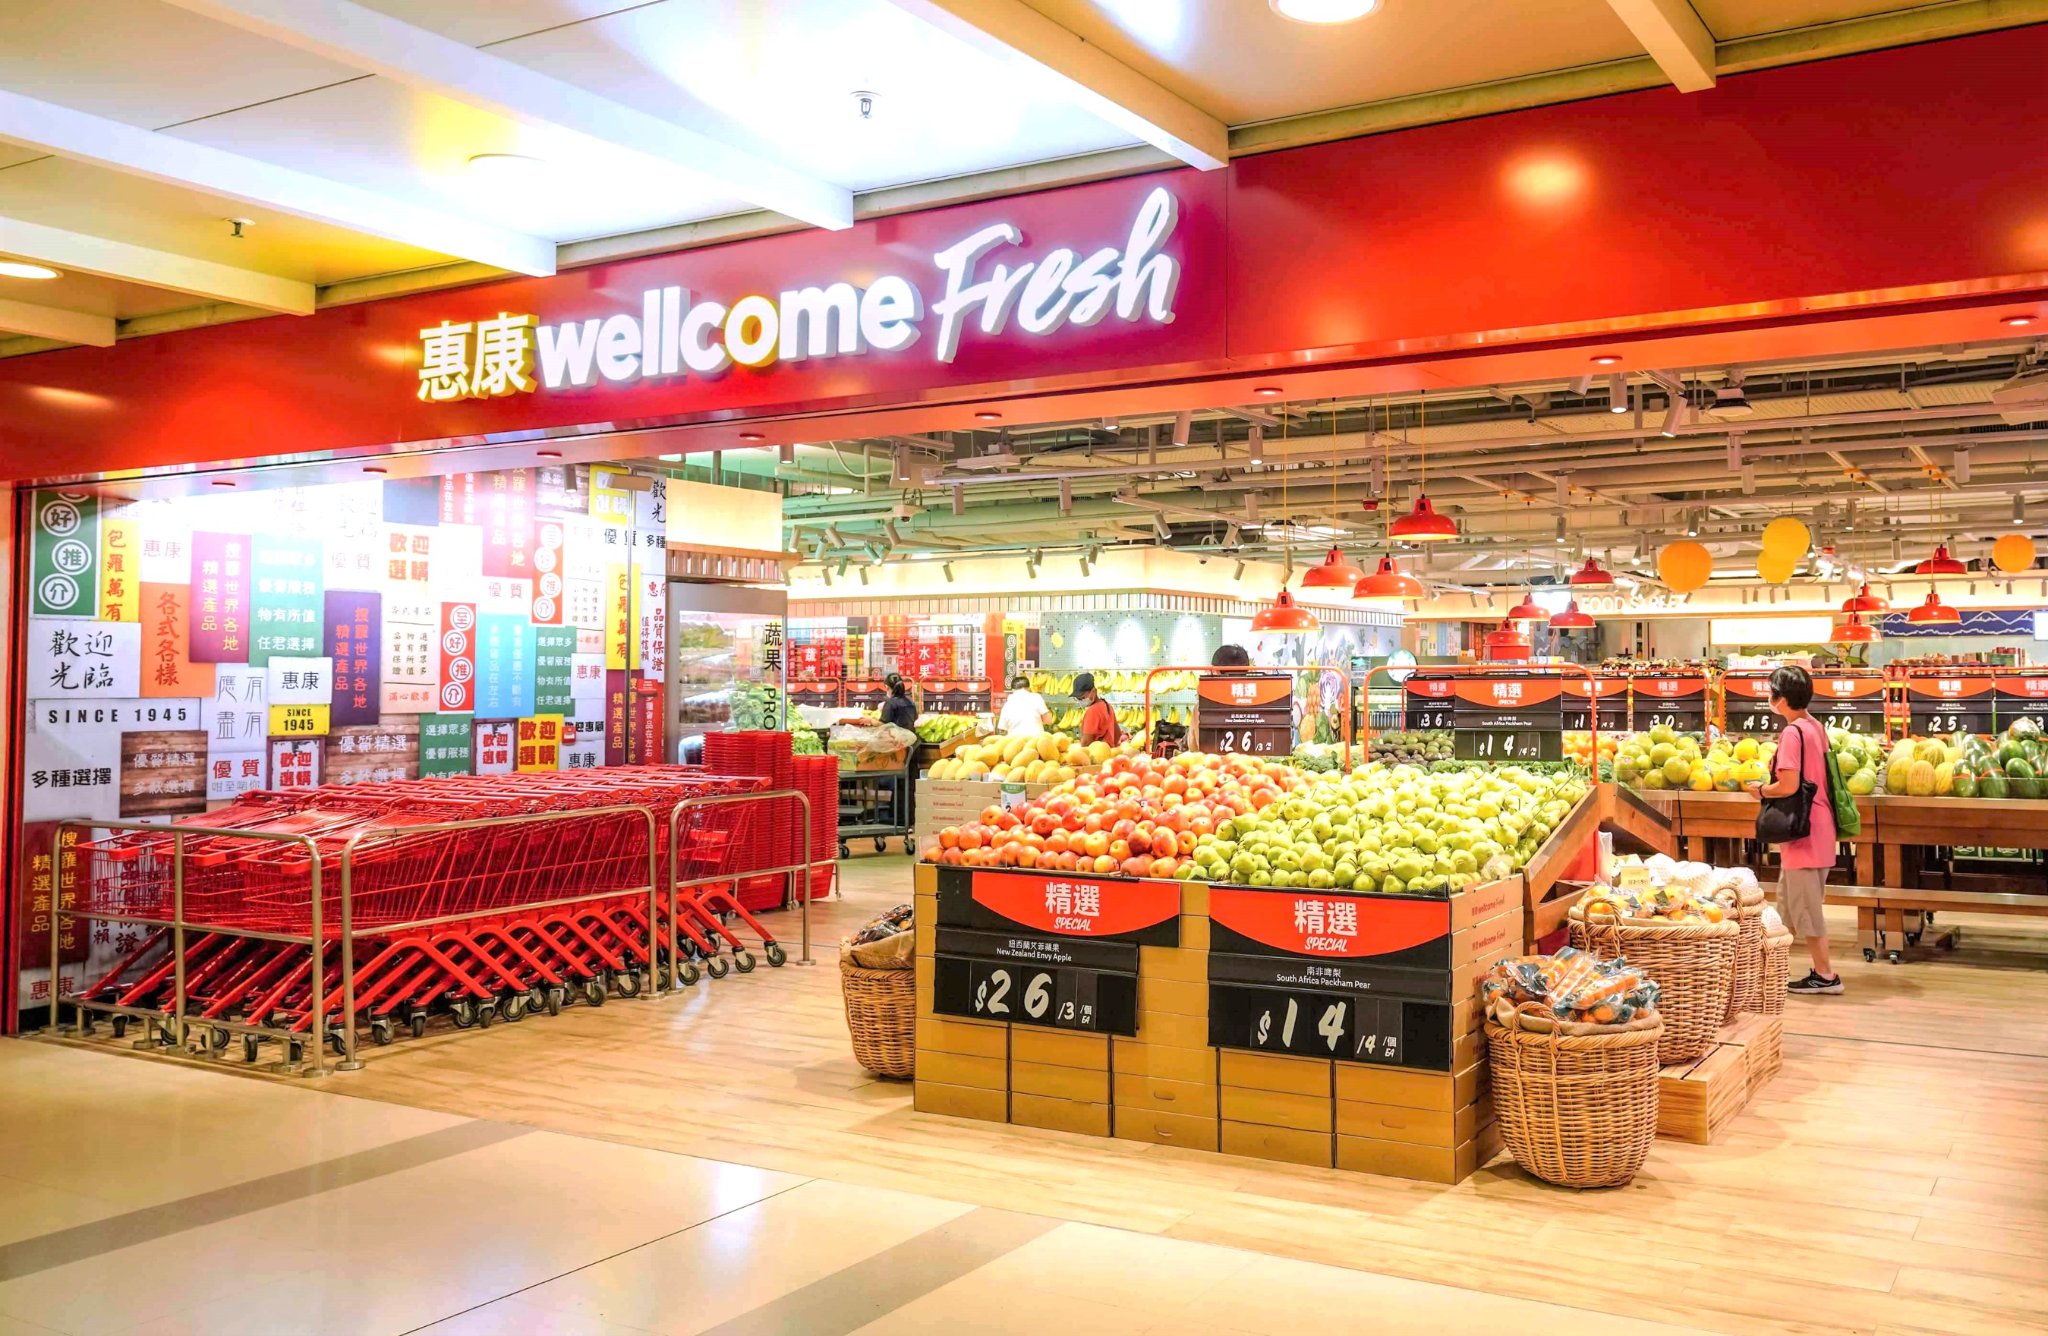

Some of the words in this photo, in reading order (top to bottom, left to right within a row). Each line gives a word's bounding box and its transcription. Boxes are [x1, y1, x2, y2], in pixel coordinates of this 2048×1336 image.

[418, 313, 537, 401] 惠康
[536, 275, 919, 387] wellcome
[934, 186, 1177, 361] Fresh
[143, 539, 182, 559] 惠康
[389, 532, 430, 556] 歡迎
[105, 529, 127, 622] 包羅萬有
[389, 559, 429, 583] 選購
[1581, 596, 1625, 613] FOOD
[257, 608, 316, 623] 物有所值
[49, 629, 114, 658] 歡迎
[155, 591, 181, 686] 各式各樣
[257, 636, 315, 651] 任君選擇
[652, 608, 665, 672] 品質保證
[764, 622, 782, 672] 蔬果
[334, 625, 349, 691] 精選產品
[448, 611, 468, 702] 至好推介
[918, 646, 932, 678] 水果
[50, 661, 114, 691] 光臨
[281, 672, 319, 691] 惠康
[576, 664, 601, 679] 惠康
[218, 675, 264, 704] 應有
[1492, 682, 1522, 698] 精選
[49, 709, 119, 724] SINCE
[135, 708, 187, 723] 1945
[287, 708, 311, 718] SINCE
[612, 692, 623, 749] 精選產品
[1744, 716, 1769, 730] $45
[216, 711, 263, 741] 盡有
[284, 719, 314, 732] 1945
[425, 723, 470, 737] 選擇眾多
[519, 720, 556, 741] 歡迎
[1928, 716, 1958, 732] $25
[339, 735, 408, 754] 優質精選
[483, 733, 508, 748] 歡迎
[1220, 731, 1252, 752] $26
[1479, 734, 1514, 757] $14
[133, 752, 196, 769] 優質精選
[280, 751, 312, 768] 歡迎
[519, 745, 556, 766] 選購
[568, 752, 596, 769] 惠康
[32, 768, 112, 789] 多種選擇
[212, 759, 260, 779] 優質
[132, 779, 194, 797] 多款選擇
[32, 855, 51, 932] 精選產品
[1045, 881, 1100, 917] 精選
[1054, 916, 1092, 932] SPECIAL
[1294, 898, 1358, 937] 精選
[1304, 936, 1348, 953] SPECIAL
[996, 947, 1010, 956] New
[1011, 949, 1036, 959] Zealand
[1036, 952, 1052, 962] Envy
[1053, 953, 1072, 963] Apple
[1276, 974, 1297, 983] South
[1298, 975, 1320, 985] Africa
[1320, 977, 1354, 988] Packham
[1354, 980, 1371, 989] Pear
[1306, 966, 1341, 978] 南非啤梨
[30, 976, 75, 1000] 惠康
[975, 969, 1052, 1019] $26
[1058, 1001, 1075, 1021] /3
[1082, 1015, 1091, 1025] EA
[1257, 997, 1347, 1052] $14
[1356, 1034, 1376, 1054] /4
[1384, 1048, 1395, 1058] EA
